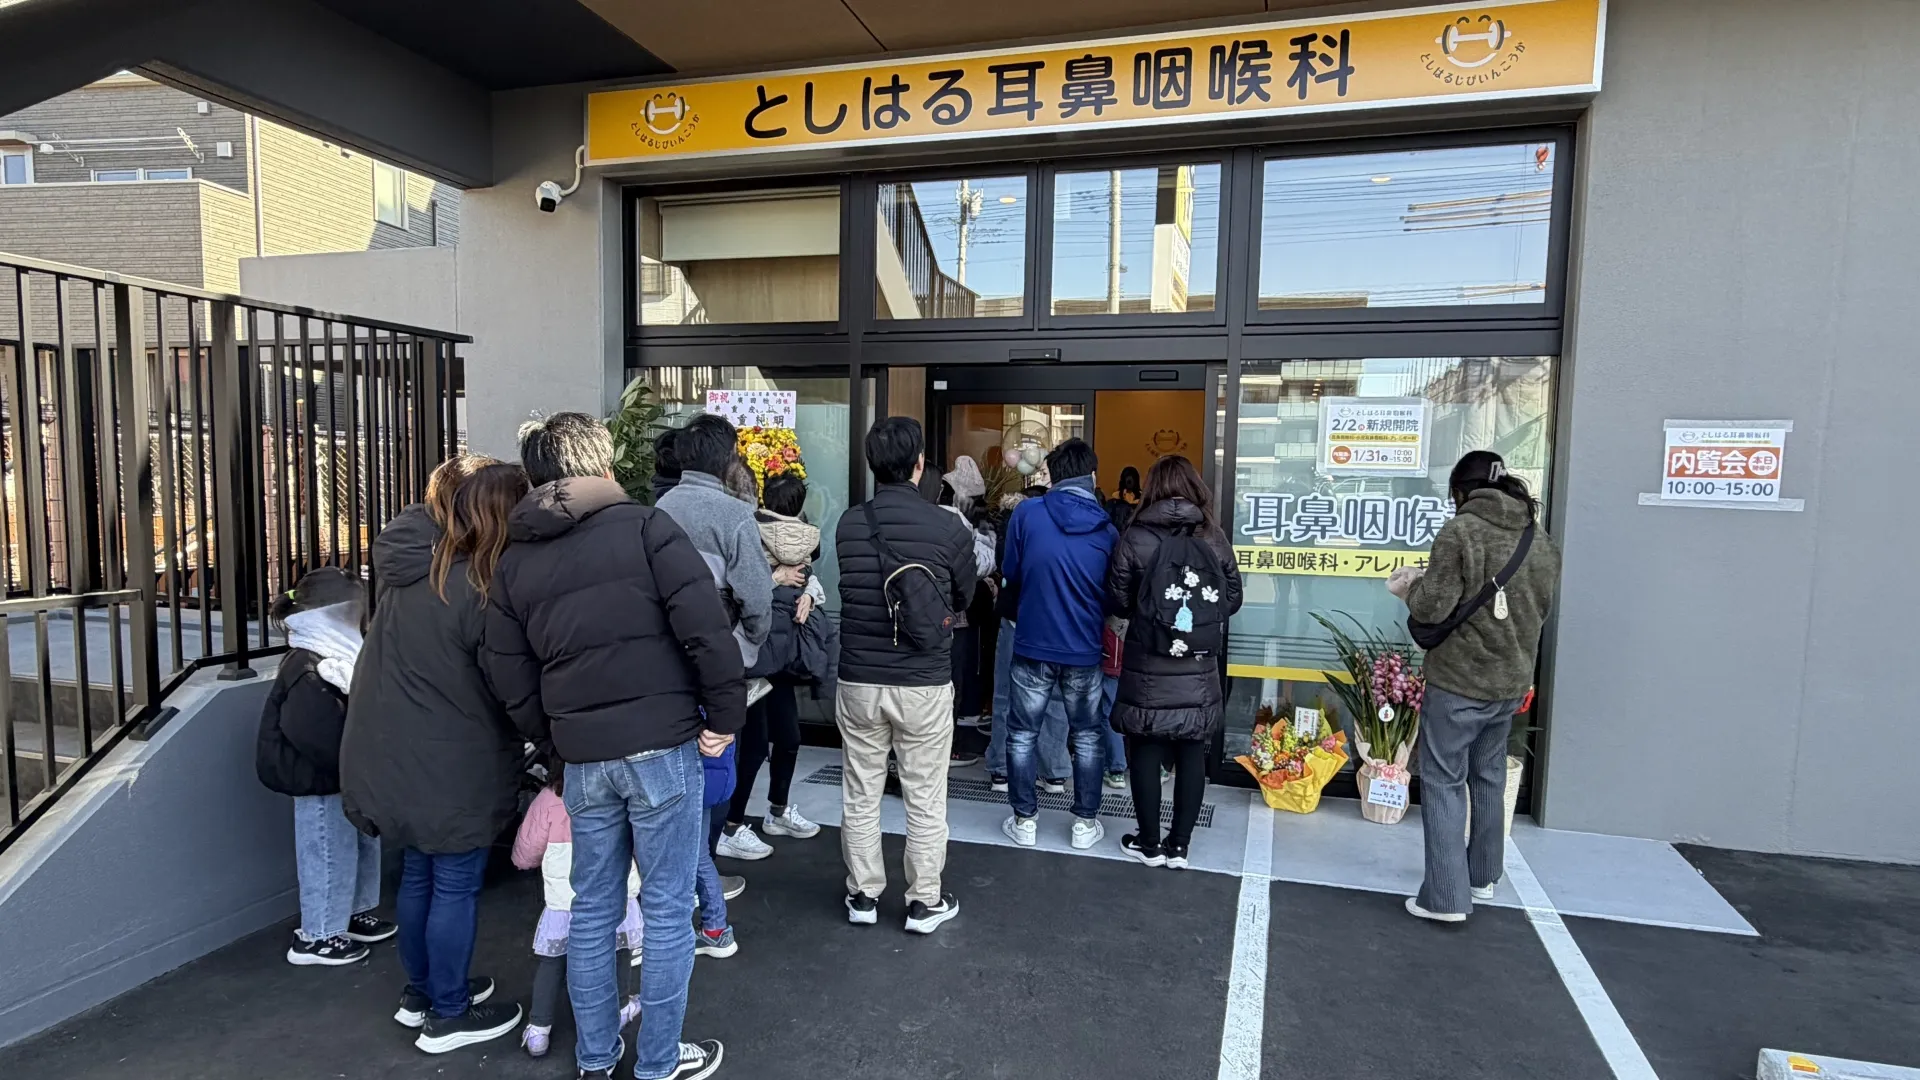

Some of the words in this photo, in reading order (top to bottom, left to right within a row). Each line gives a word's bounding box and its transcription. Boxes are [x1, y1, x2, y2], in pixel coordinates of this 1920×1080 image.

[1420, 42, 1526, 86] としはるじびいんこうか
[744, 28, 1355, 139] としはる耳鼻咽喉科
[631, 114, 700, 149] としはるじびいんこうか
[1332, 419, 1356, 431] 2/2
[1366, 420, 1418, 431] 新規開院
[1353, 449, 1381, 462] 1/31
[1671, 449, 1748, 476] 内覧会
[1752, 456, 1773, 465] 本日
[1241, 493, 1456, 545] 耳鼻咽喉
